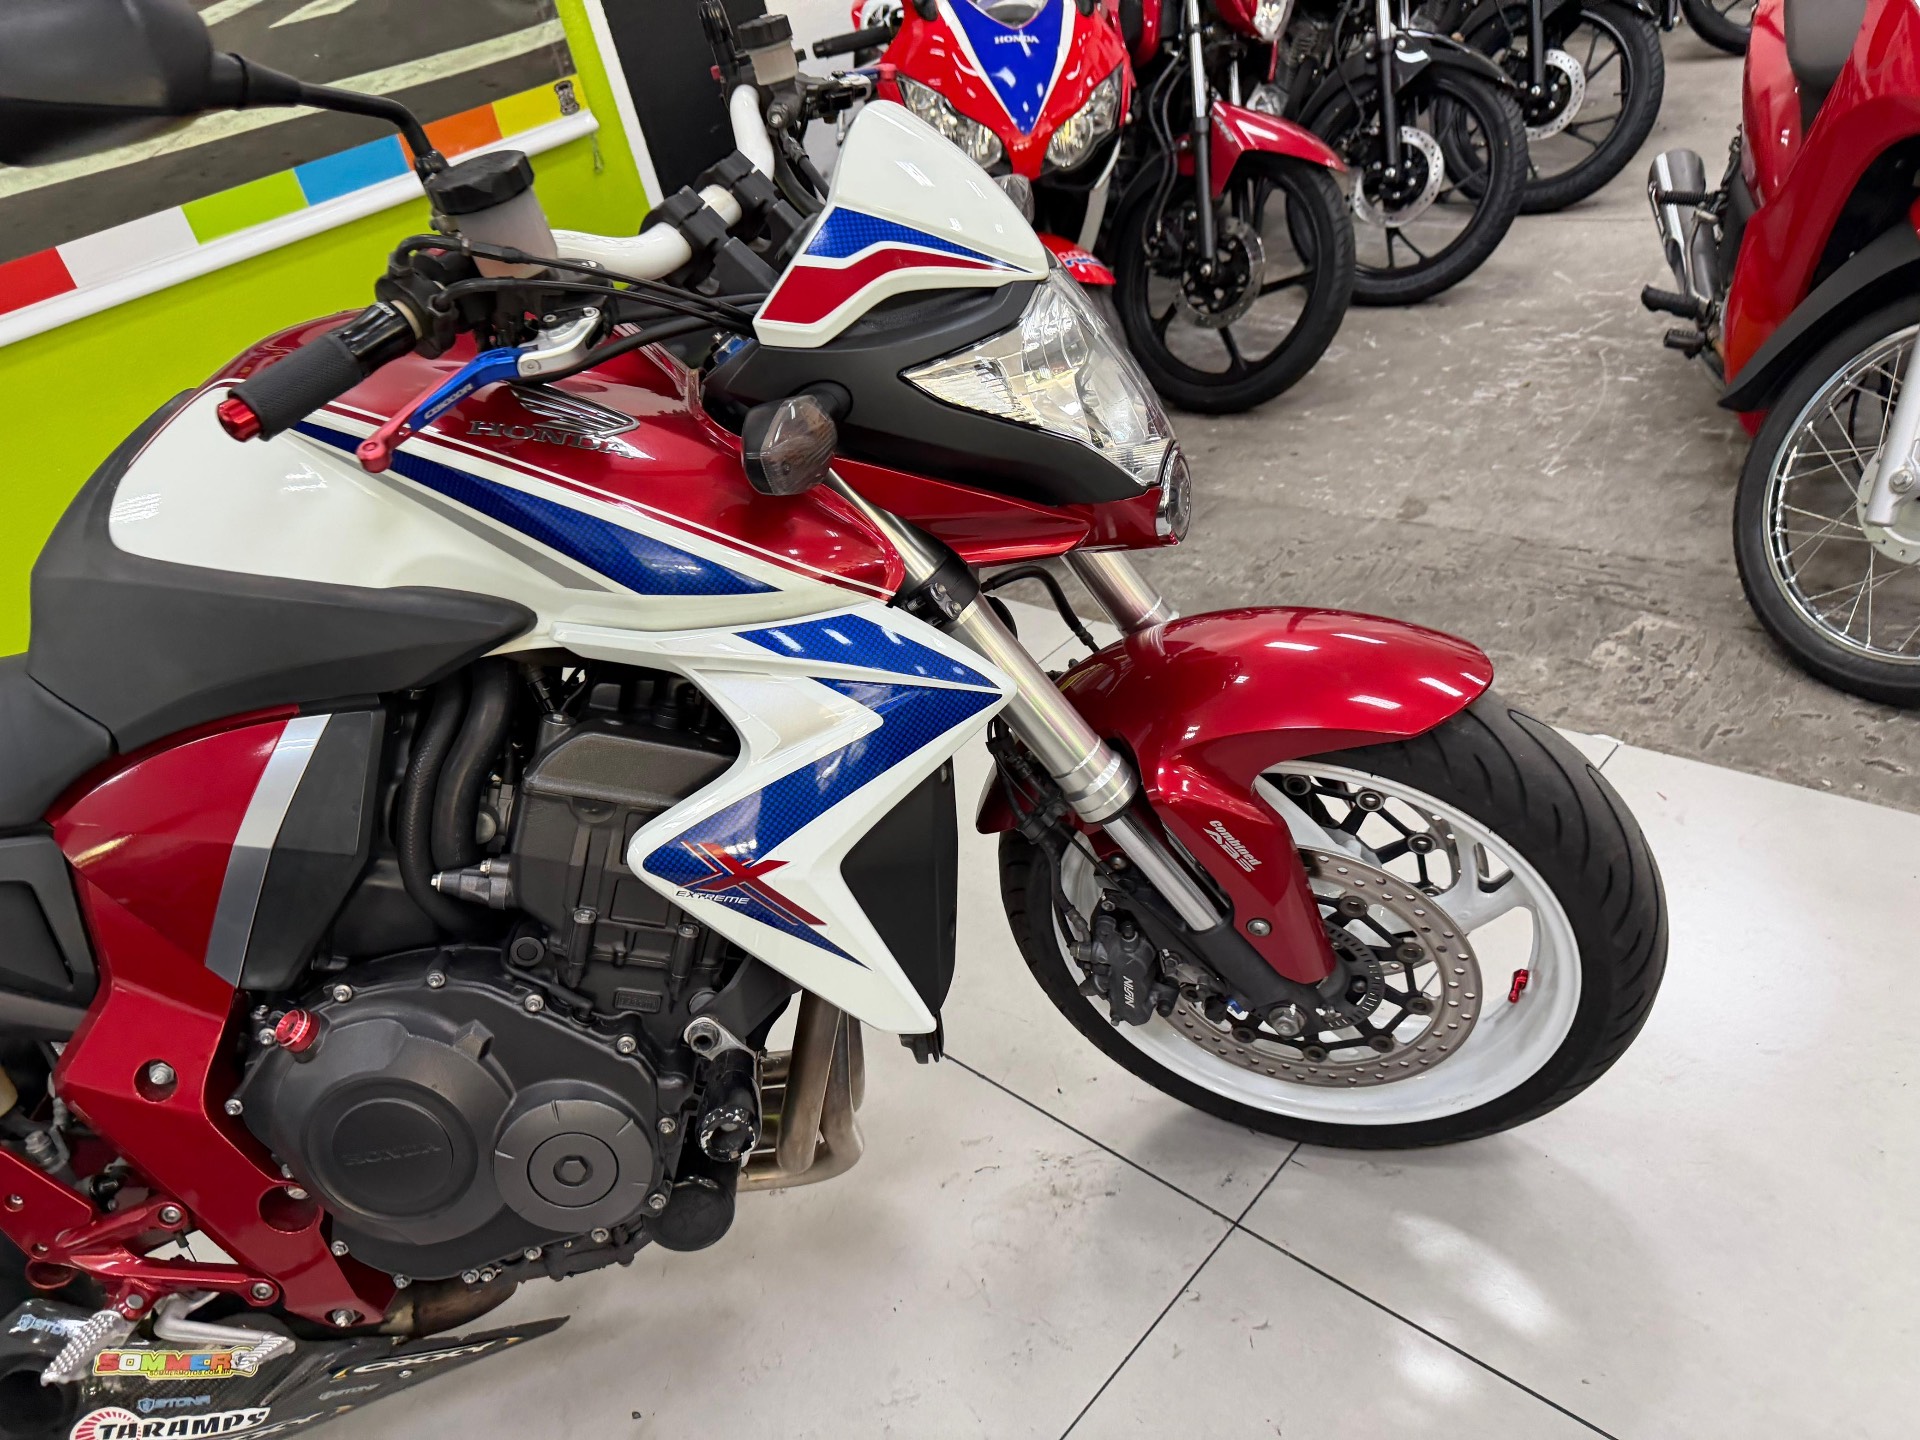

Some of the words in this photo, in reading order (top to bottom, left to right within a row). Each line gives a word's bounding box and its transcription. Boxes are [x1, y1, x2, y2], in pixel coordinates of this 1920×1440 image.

[994, 34, 1039, 44] HONDA
[466, 420, 634, 459] HONDA
[1202, 827, 1256, 872] ABS
[1209, 820, 1262, 866] Combined
[675, 889, 751, 904] EXTREME
[99, 1410, 267, 1440] TARAMPS
